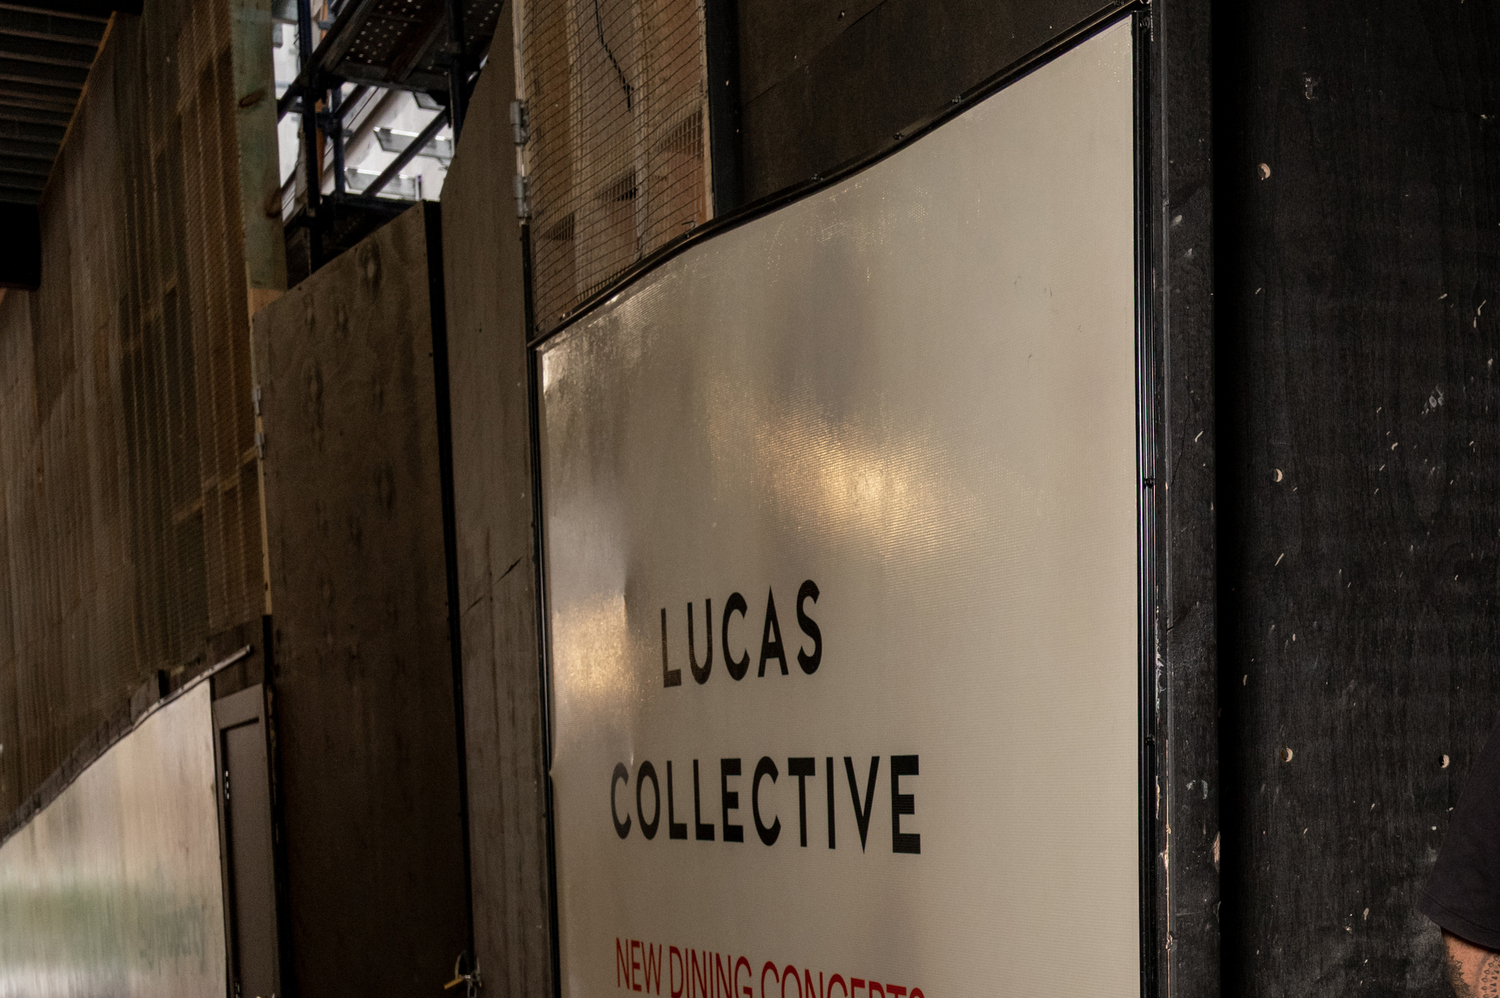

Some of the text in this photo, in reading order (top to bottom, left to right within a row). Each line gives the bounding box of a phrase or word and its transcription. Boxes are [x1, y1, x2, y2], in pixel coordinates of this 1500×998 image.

[661, 579, 822, 688] LUCAS
[610, 755, 921, 855] COLLECTIVE
[616, 937, 662, 996] NEW
